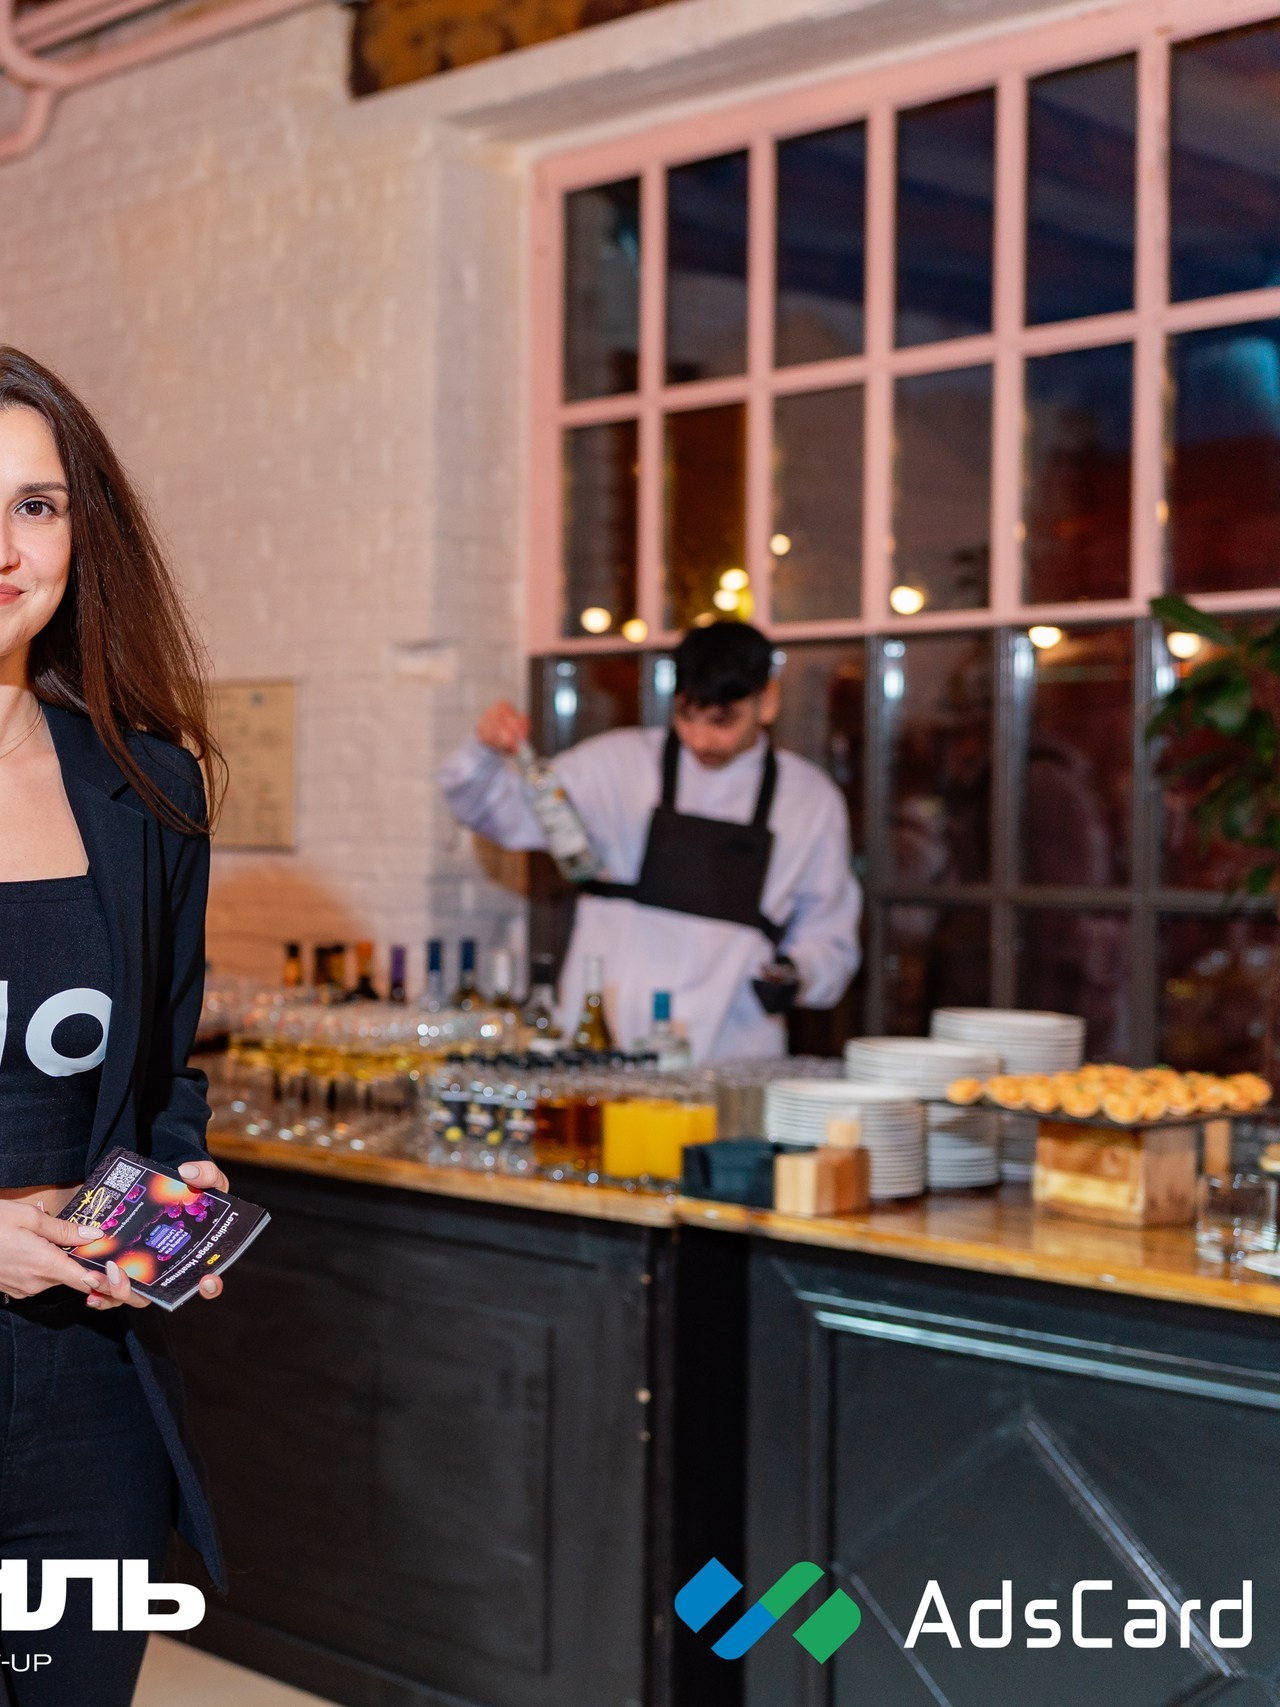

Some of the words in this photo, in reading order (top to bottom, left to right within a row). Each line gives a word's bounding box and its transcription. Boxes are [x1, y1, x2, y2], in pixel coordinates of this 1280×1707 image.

[210, 1211, 239, 1242] Landing
[195, 1241, 214, 1259] page
[160, 1258, 199, 1287] Heatmaps
